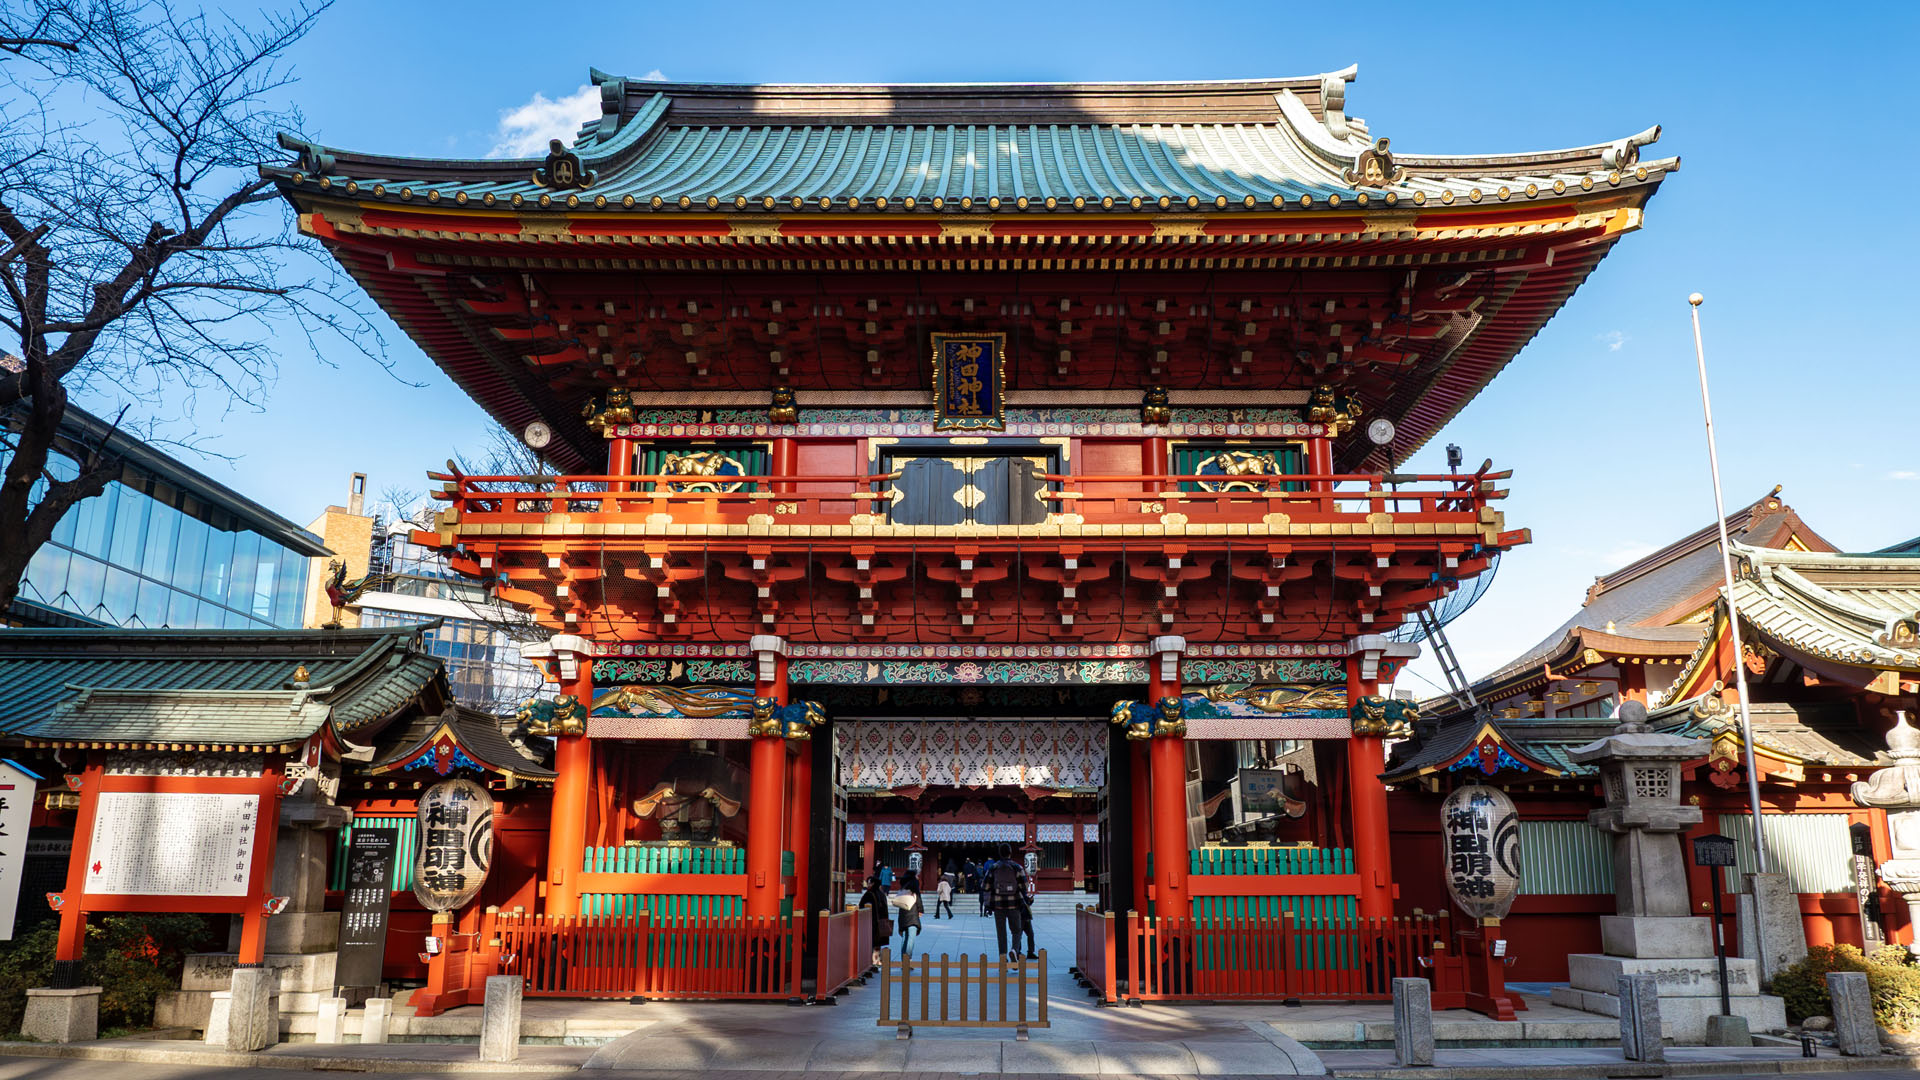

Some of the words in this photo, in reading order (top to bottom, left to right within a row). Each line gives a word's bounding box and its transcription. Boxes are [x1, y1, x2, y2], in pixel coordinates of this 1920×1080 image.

[956, 343, 983, 416] 神田神社
[233, 800, 253, 882] 神田神社御由緒
[423, 801, 469, 891] 神田明神
[1447, 807, 1495, 898] 神田明神
